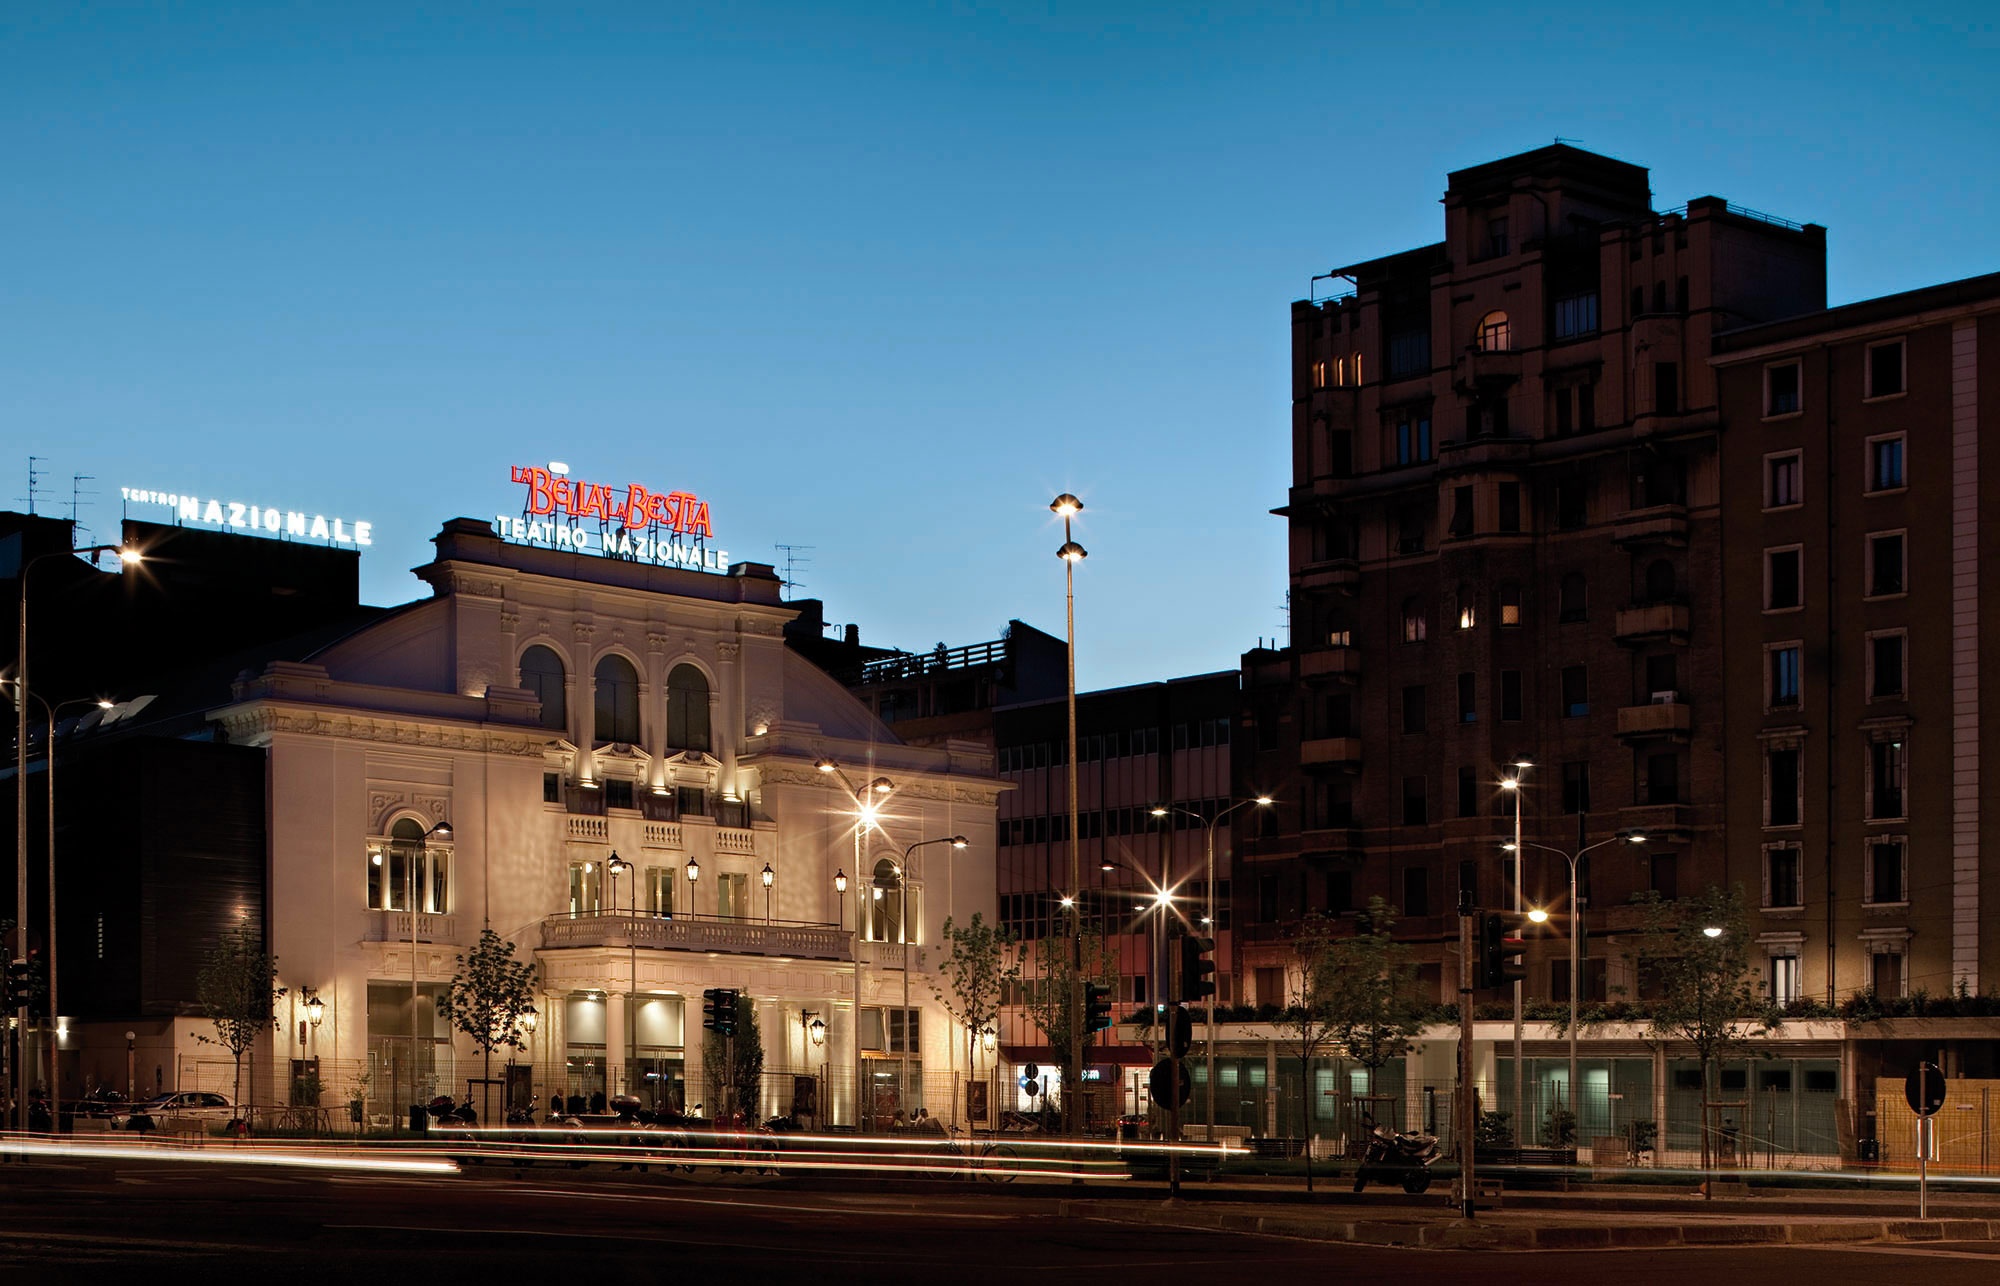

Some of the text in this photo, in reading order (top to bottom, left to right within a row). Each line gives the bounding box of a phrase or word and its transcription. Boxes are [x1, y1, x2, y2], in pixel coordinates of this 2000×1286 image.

[121, 486, 373, 546] TEATRO NAZIONALE
[511, 465, 531, 483] LA
[530, 467, 609, 520] BELLA
[608, 499, 627, 518] LA
[624, 484, 713, 537] BESTIA
[495, 515, 729, 570] TEATRO NAZIONALE
